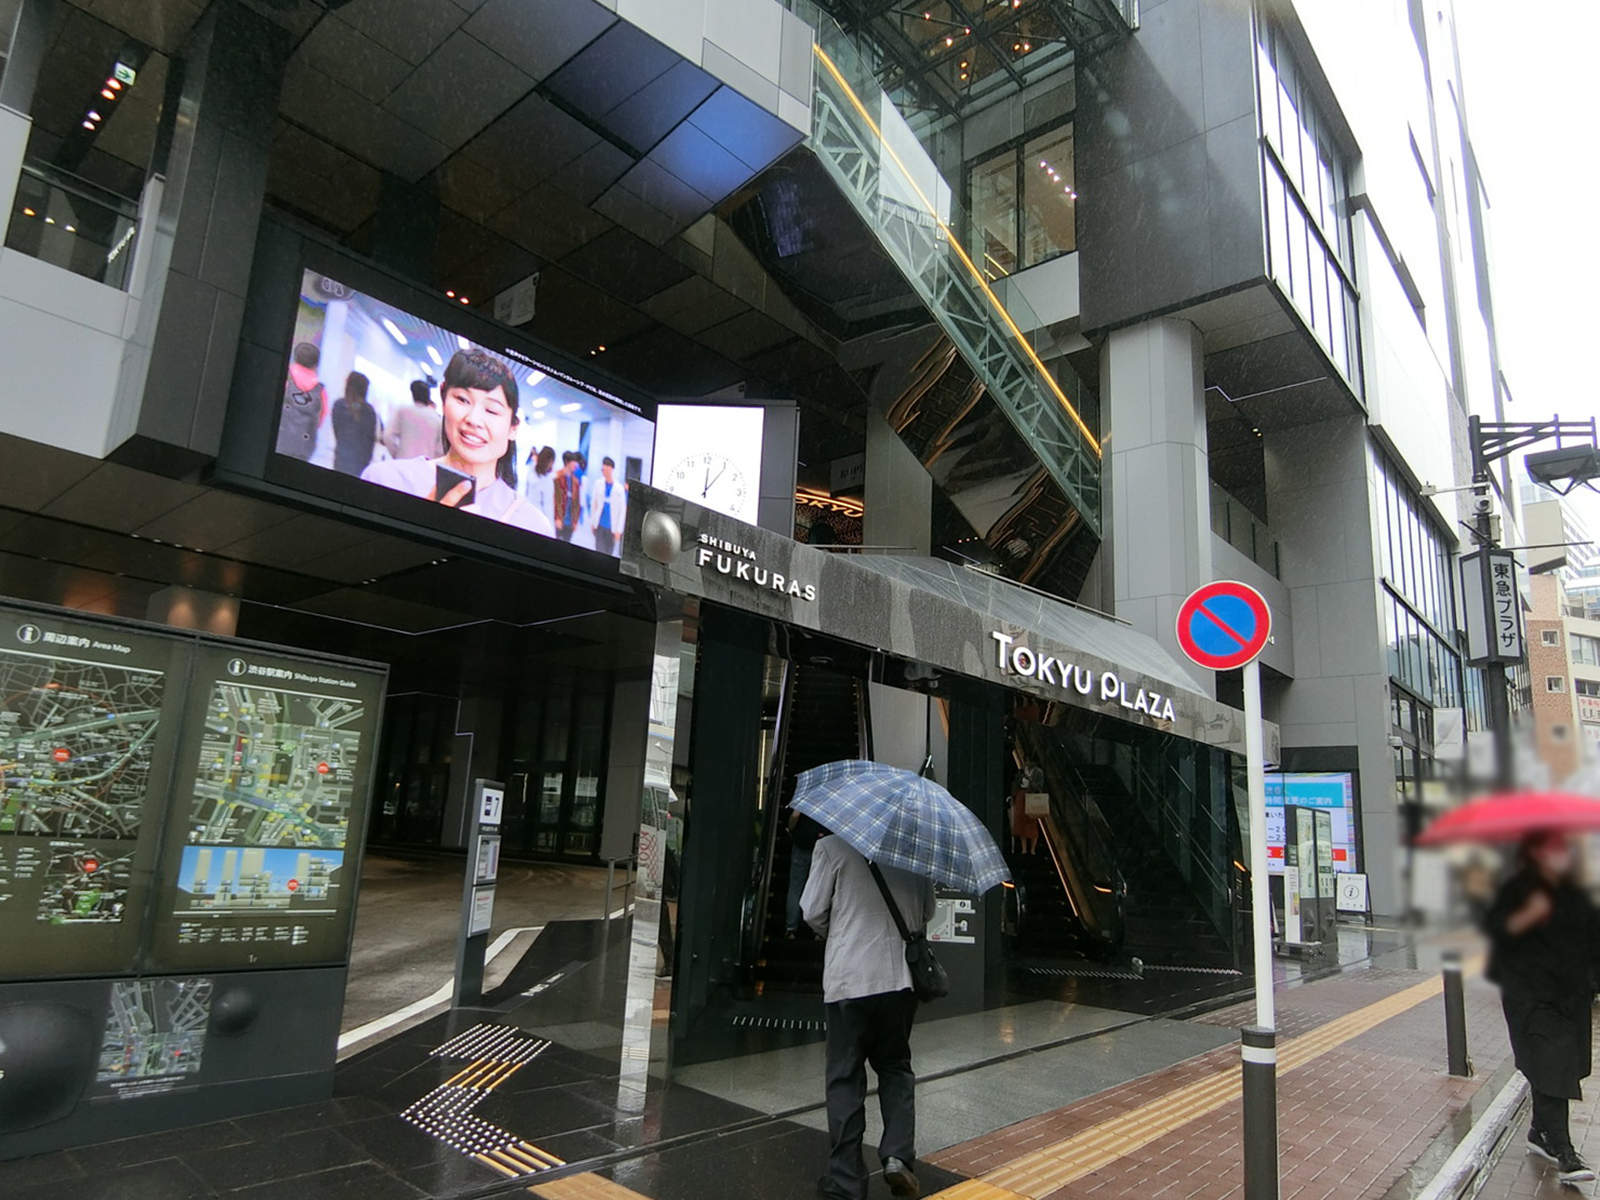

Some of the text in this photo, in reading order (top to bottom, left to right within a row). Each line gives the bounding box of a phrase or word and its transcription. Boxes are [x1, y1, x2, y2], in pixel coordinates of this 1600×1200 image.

[700, 533, 756, 561] SHIBUYA
[699, 548, 816, 601] FUKURAS
[1493, 563, 1516, 648] 東急プラザ
[92, 640, 112, 650] Area
[112, 643, 132, 654] Map
[294, 672, 318, 683] Shibuya
[318, 676, 339, 686] Station
[339, 679, 357, 688] Guide
[992, 630, 1176, 722] TOKYU PLAZA
